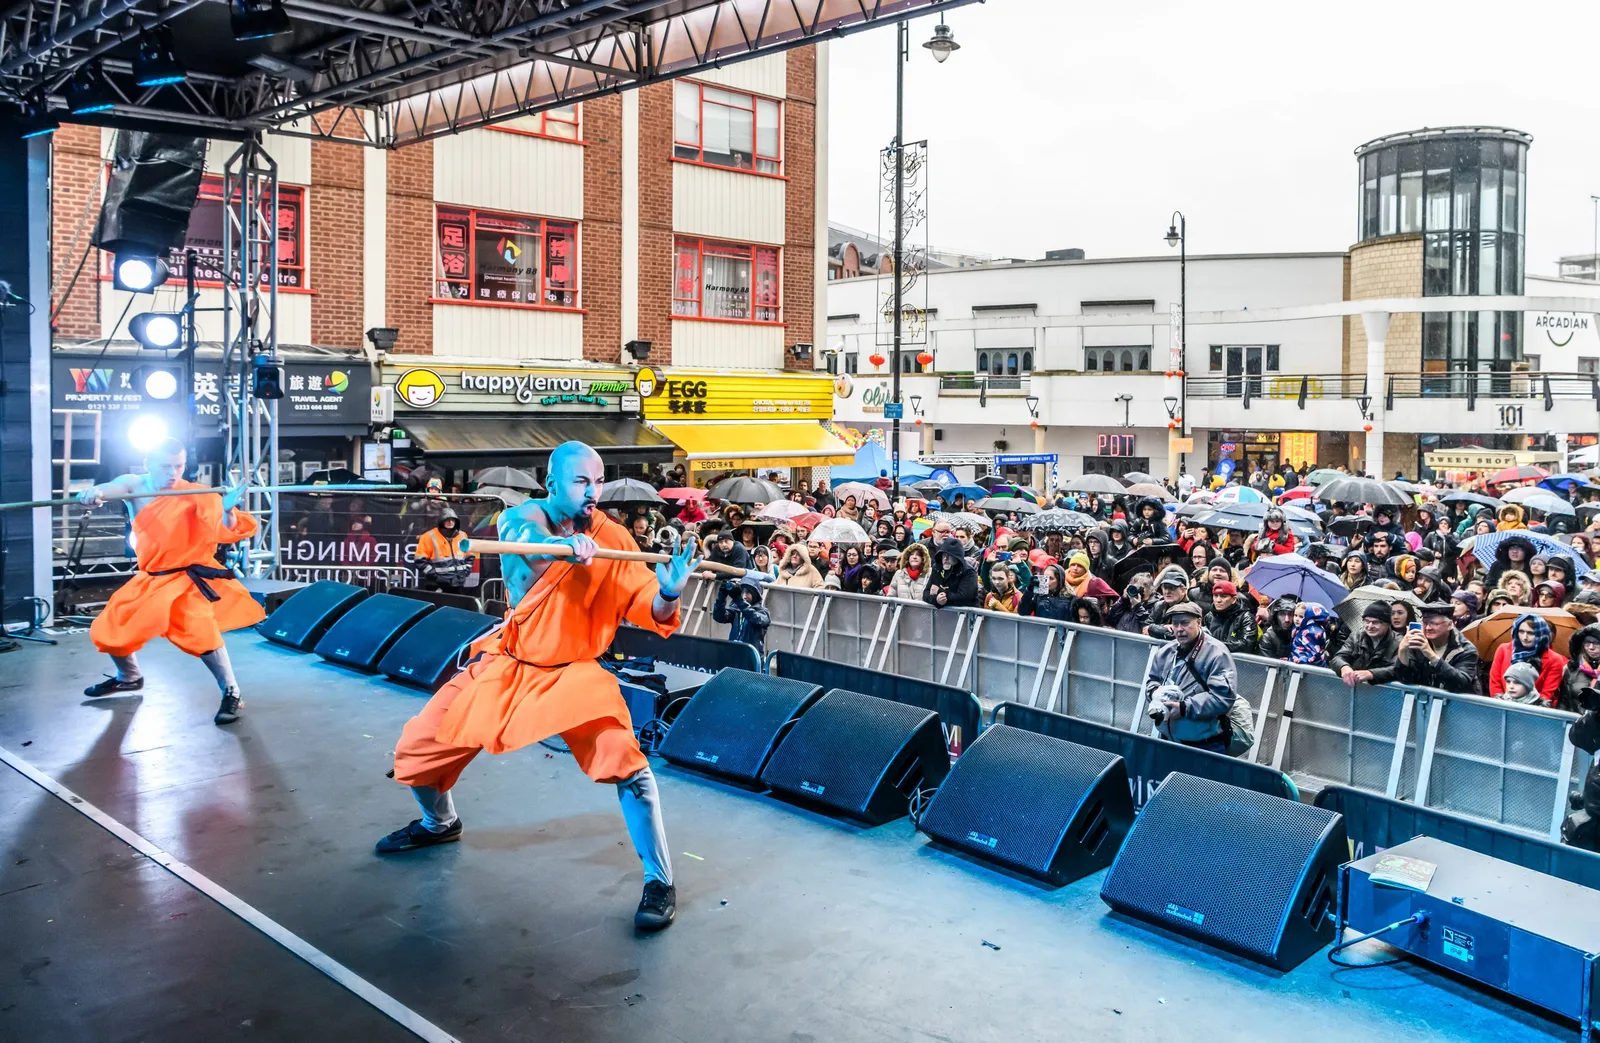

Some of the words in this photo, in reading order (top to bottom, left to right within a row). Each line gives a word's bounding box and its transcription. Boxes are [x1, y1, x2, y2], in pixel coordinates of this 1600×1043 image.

[442, 226, 465, 274] 足浴
[195, 267, 241, 281] heah
[480, 263, 524, 275] Harmony
[526, 267, 538, 276] 88
[705, 284, 738, 293] Harmony
[1535, 316, 1588, 329] ARCADIAN
[589, 380, 630, 396] premier
[668, 380, 707, 399] EGG
[65, 394, 112, 402] PROPERTY
[1498, 405, 1523, 427] 101
[1098, 434, 1134, 457] POT
[1429, 456, 1471, 464] SWEET
[1477, 457, 1512, 465] SHOP
